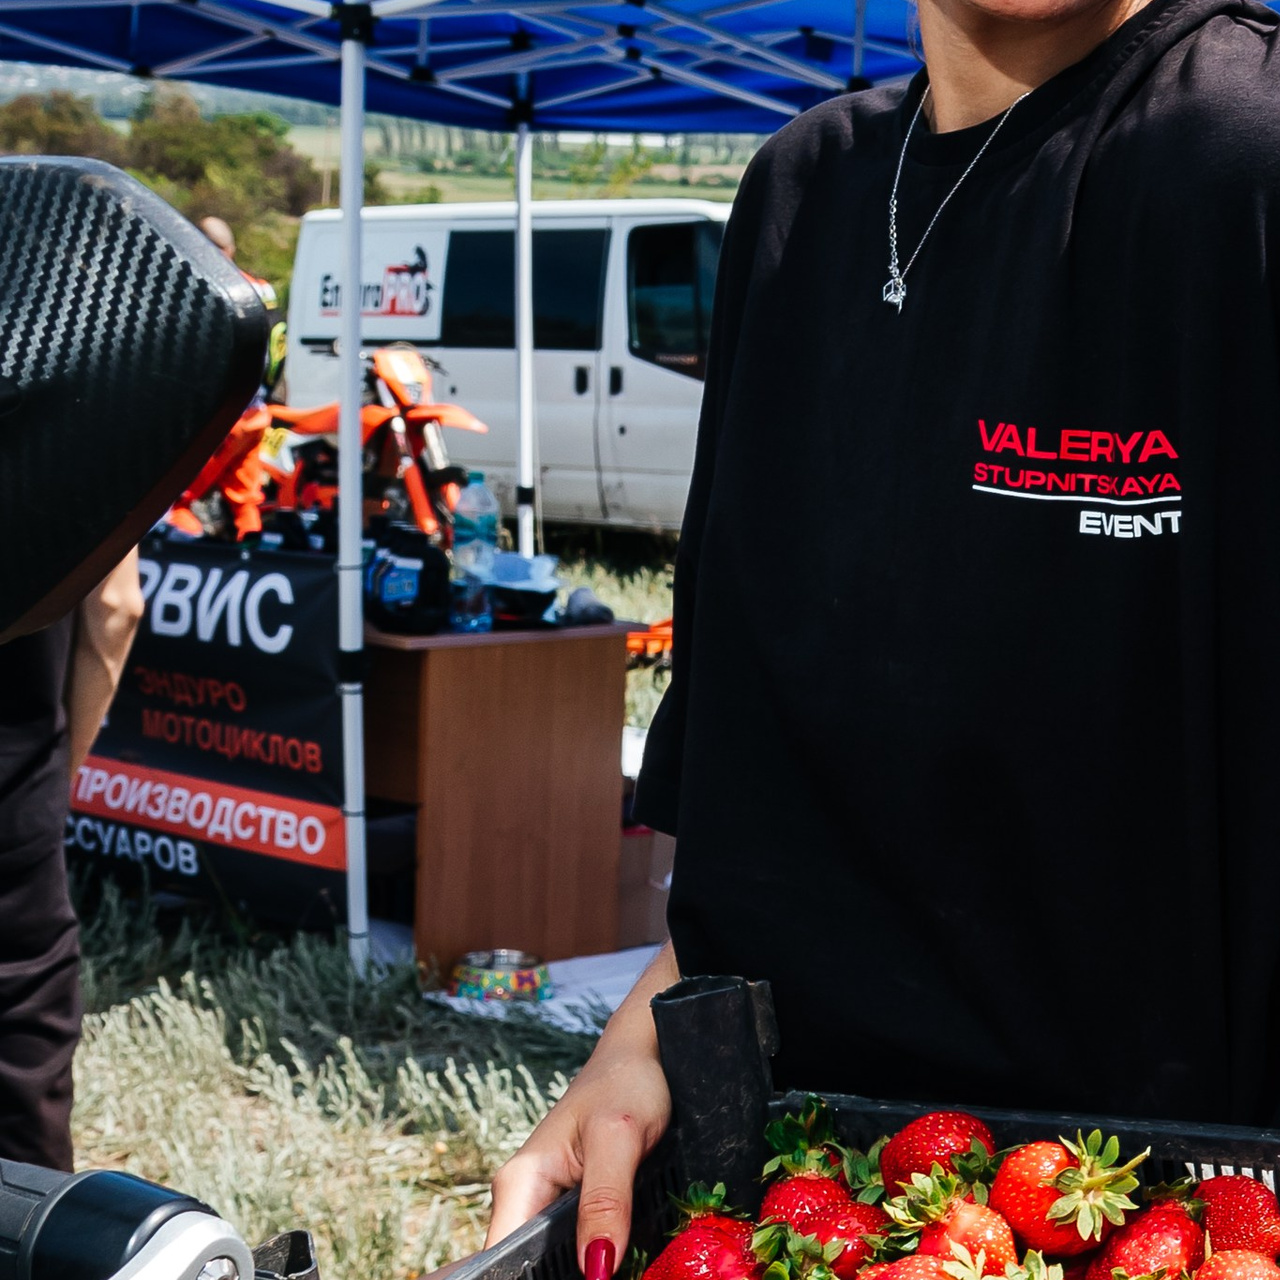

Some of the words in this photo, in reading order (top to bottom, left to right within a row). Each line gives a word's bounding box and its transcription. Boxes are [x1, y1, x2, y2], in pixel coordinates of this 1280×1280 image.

[978, 419, 1179, 464] VALERYA
[974, 463, 1182, 496] STUPNITSKAYA
[1079, 510, 1182, 538] EVENT
[142, 708, 323, 773] МОТОЦИКЛОВ
